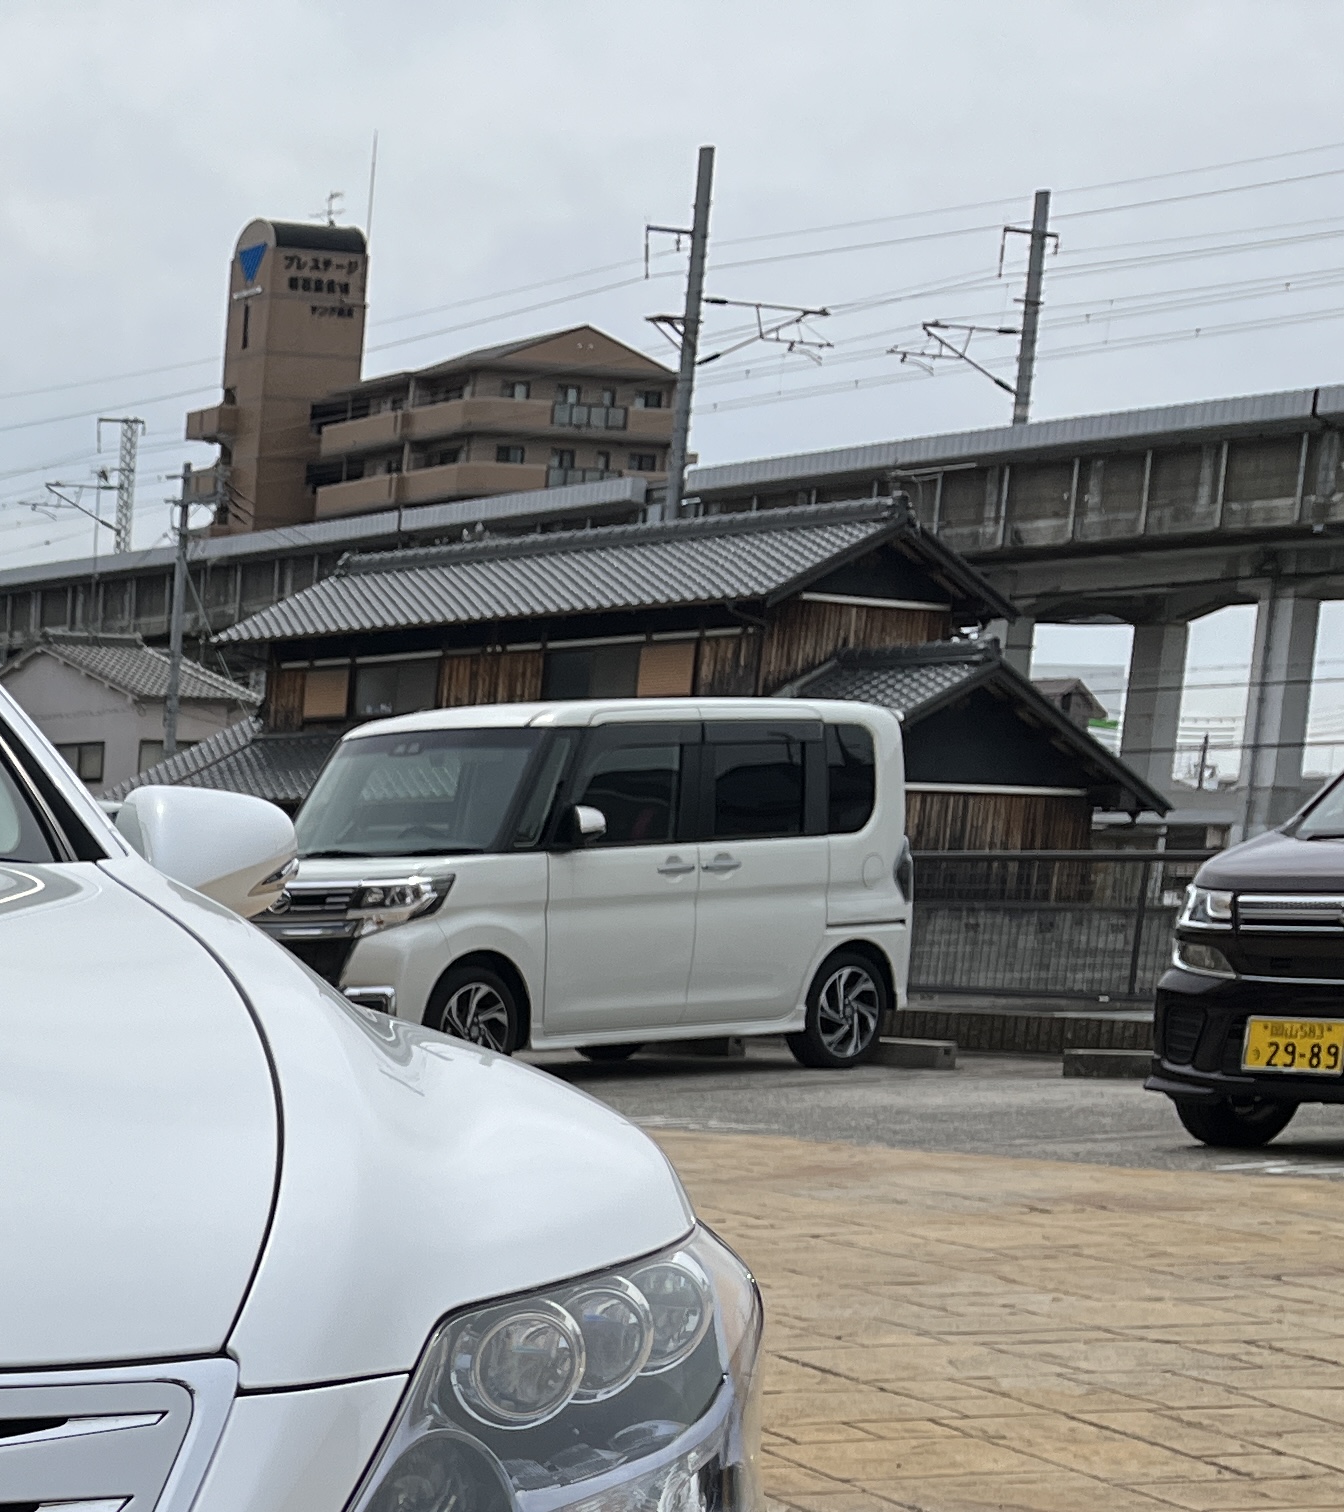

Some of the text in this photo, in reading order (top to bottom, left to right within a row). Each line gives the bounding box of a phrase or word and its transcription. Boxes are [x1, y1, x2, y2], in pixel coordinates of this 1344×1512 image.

[284, 255, 359, 275] プレステージ
[1265, 1041, 1339, 1070] 29-89
